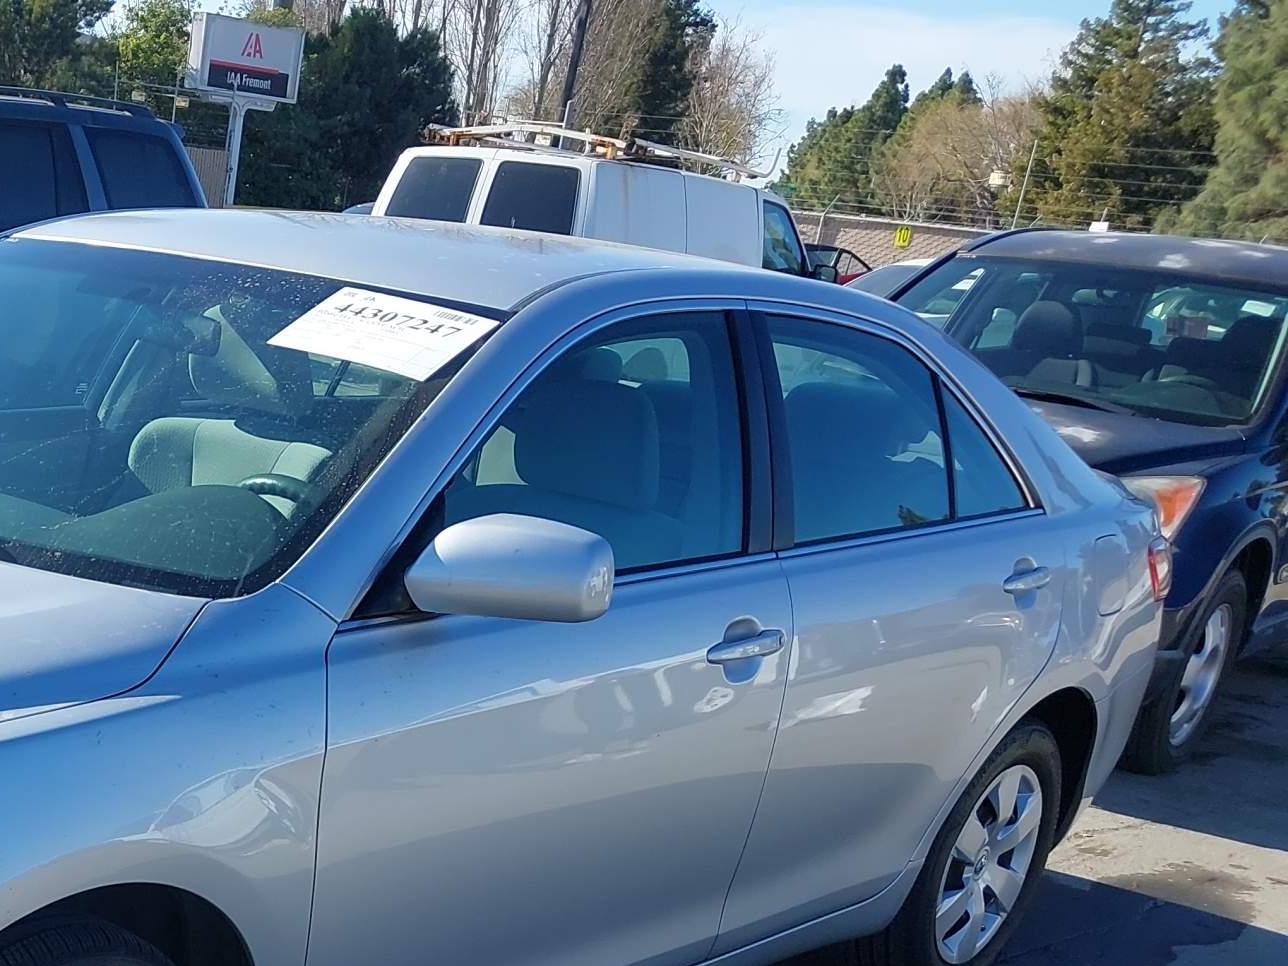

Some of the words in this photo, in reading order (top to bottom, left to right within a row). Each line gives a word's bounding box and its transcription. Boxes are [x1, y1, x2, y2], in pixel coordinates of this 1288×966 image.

[227, 71, 241, 85] IAA
[242, 73, 272, 90] Fremont
[897, 226, 910, 243] 10
[333, 303, 463, 338] 44307247
